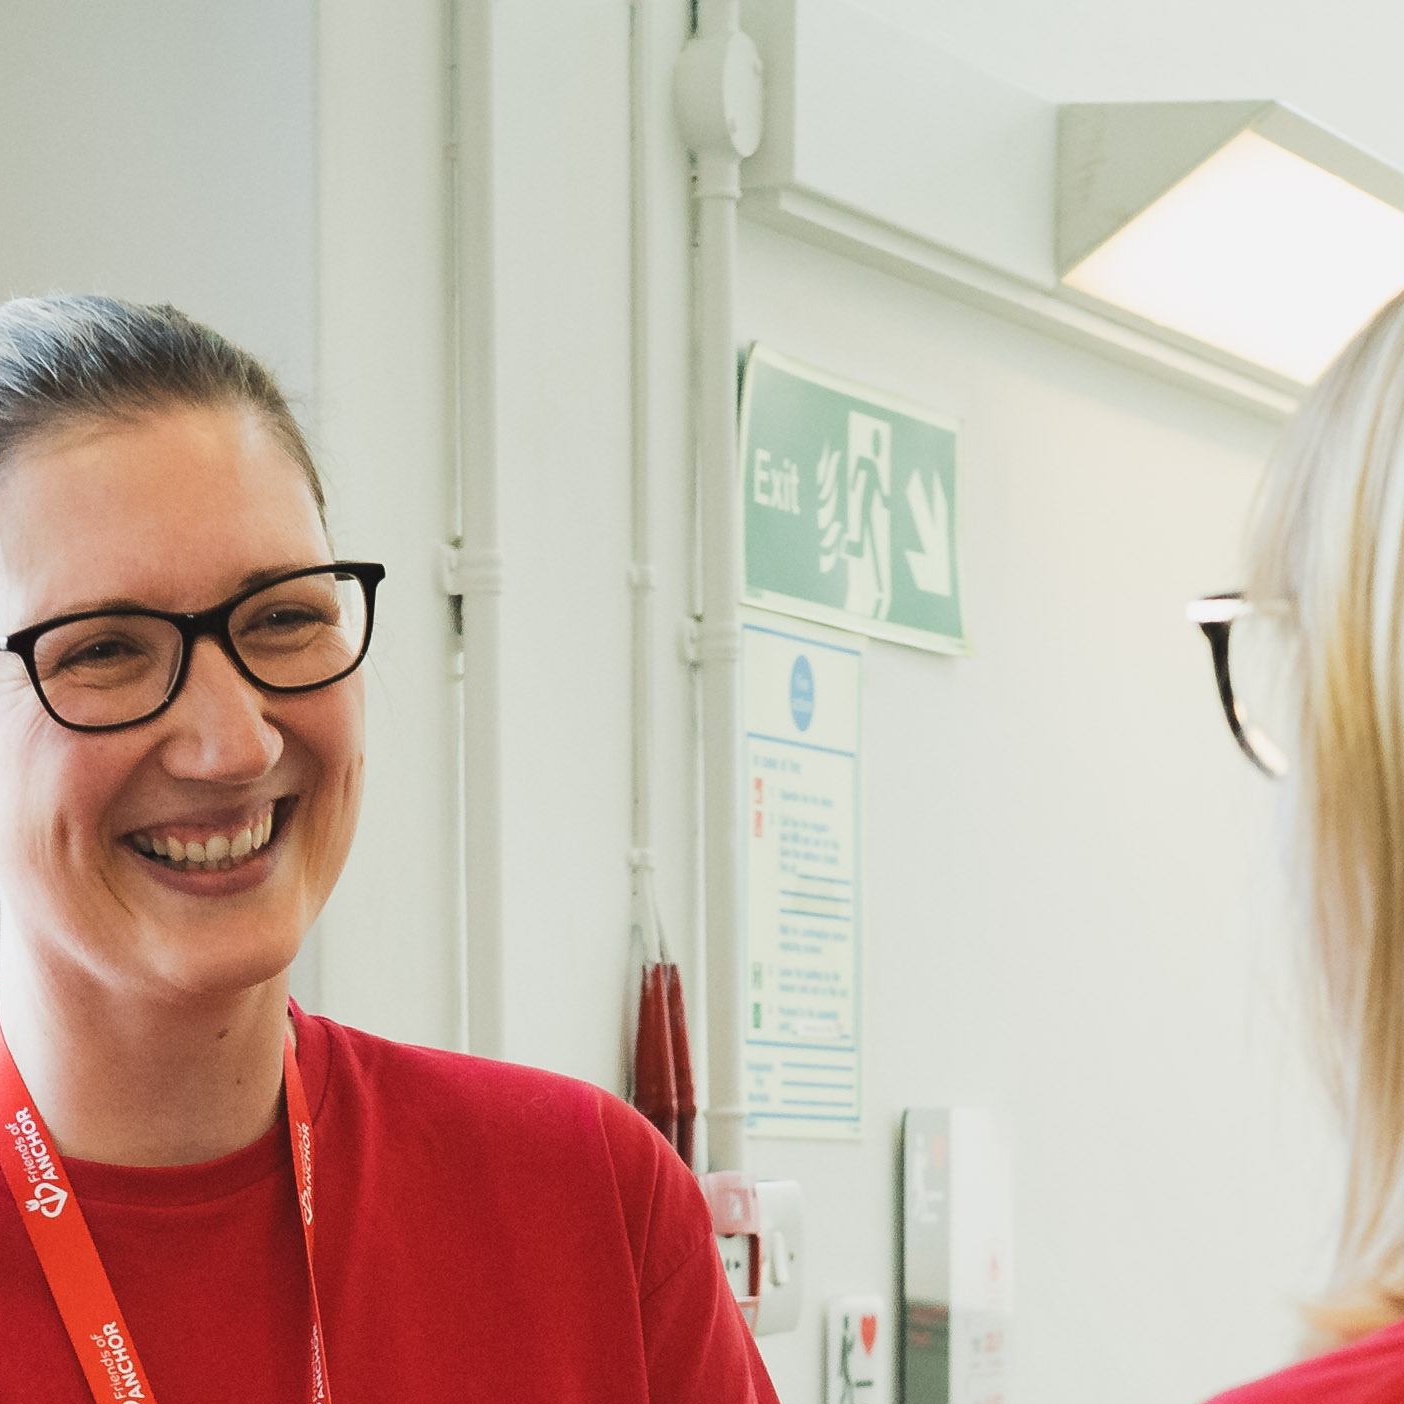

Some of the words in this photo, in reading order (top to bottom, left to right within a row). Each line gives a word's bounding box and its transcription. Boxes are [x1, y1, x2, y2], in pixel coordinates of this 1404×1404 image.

[753, 448, 801, 515] Exit
[5, 1123, 20, 1136] of
[16, 1107, 59, 1180] ANCHOR
[15, 1136, 41, 1183] Friends
[90, 1334, 106, 1348] of
[103, 1321, 145, 1398] ANCHOR
[100, 1350, 126, 1400] Friends
